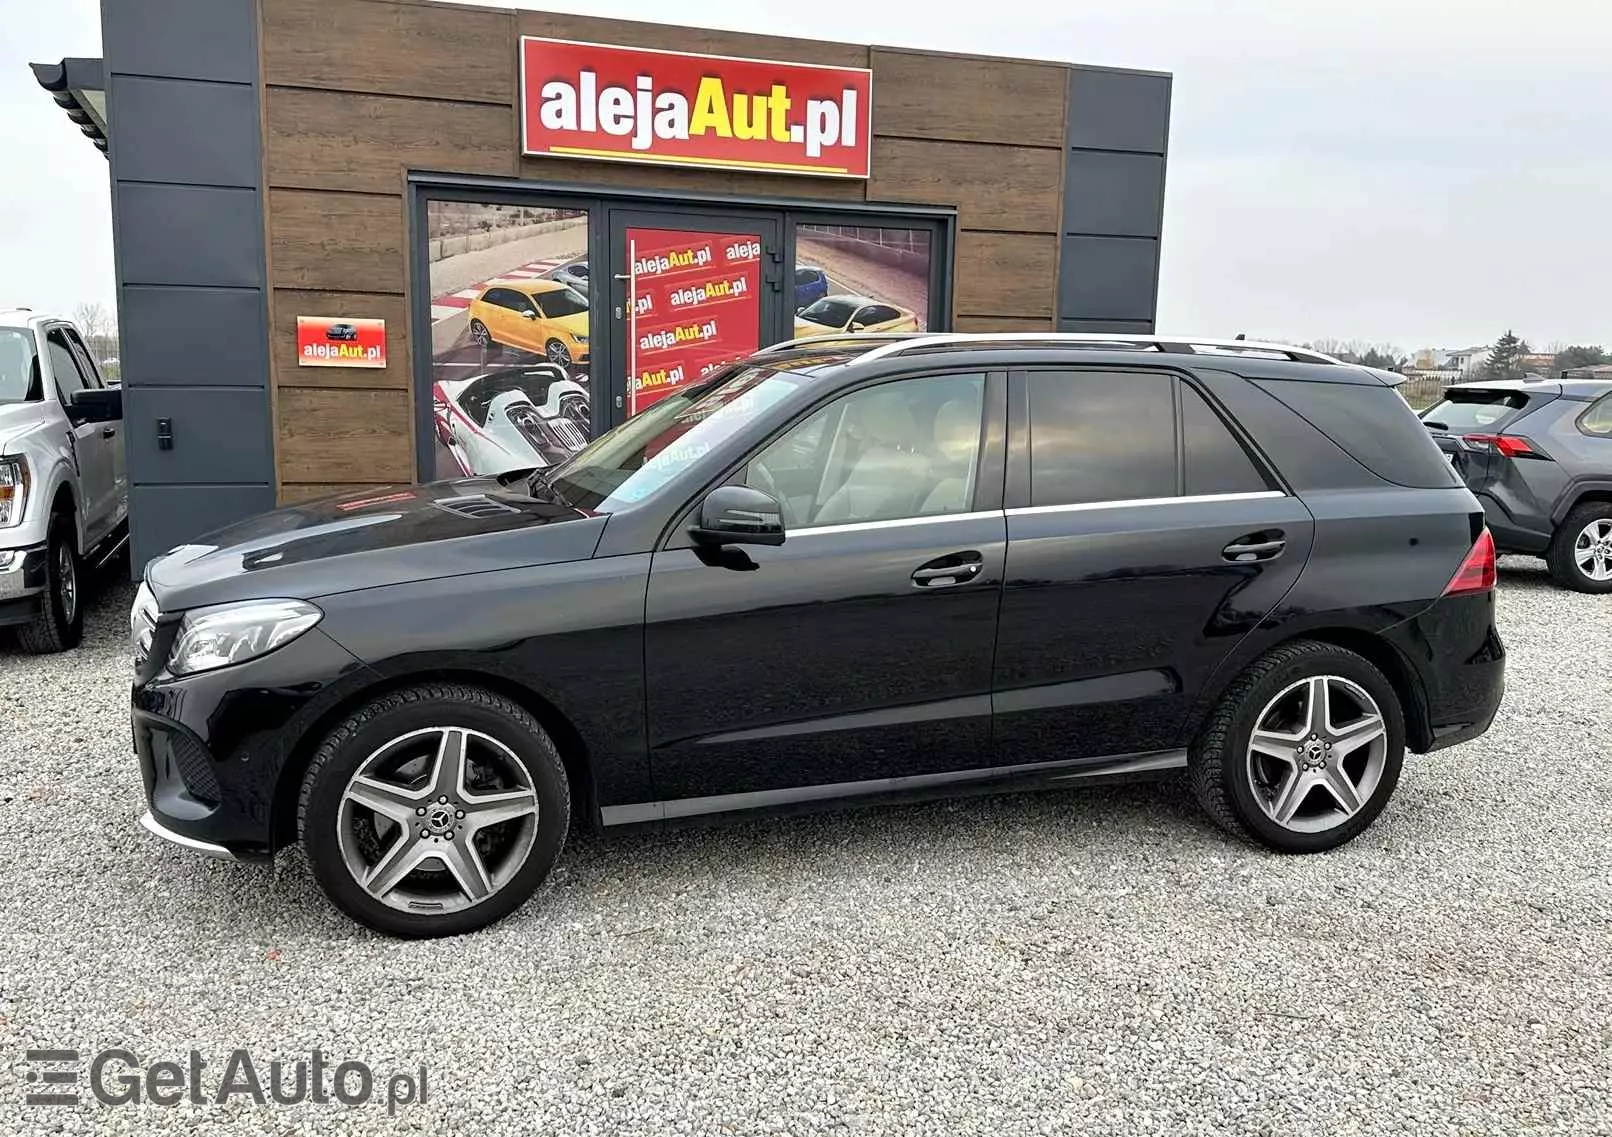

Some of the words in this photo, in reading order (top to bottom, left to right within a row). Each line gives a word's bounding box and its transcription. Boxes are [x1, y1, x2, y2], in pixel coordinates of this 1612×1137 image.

[540, 71, 857, 157] alejaAut.pl
[634, 246, 712, 275] alejaAut.pl
[670, 277, 747, 306] alejaAut.pl
[639, 320, 718, 350] alejaAut.pl
[303, 343, 381, 360] alejaAut.pl
